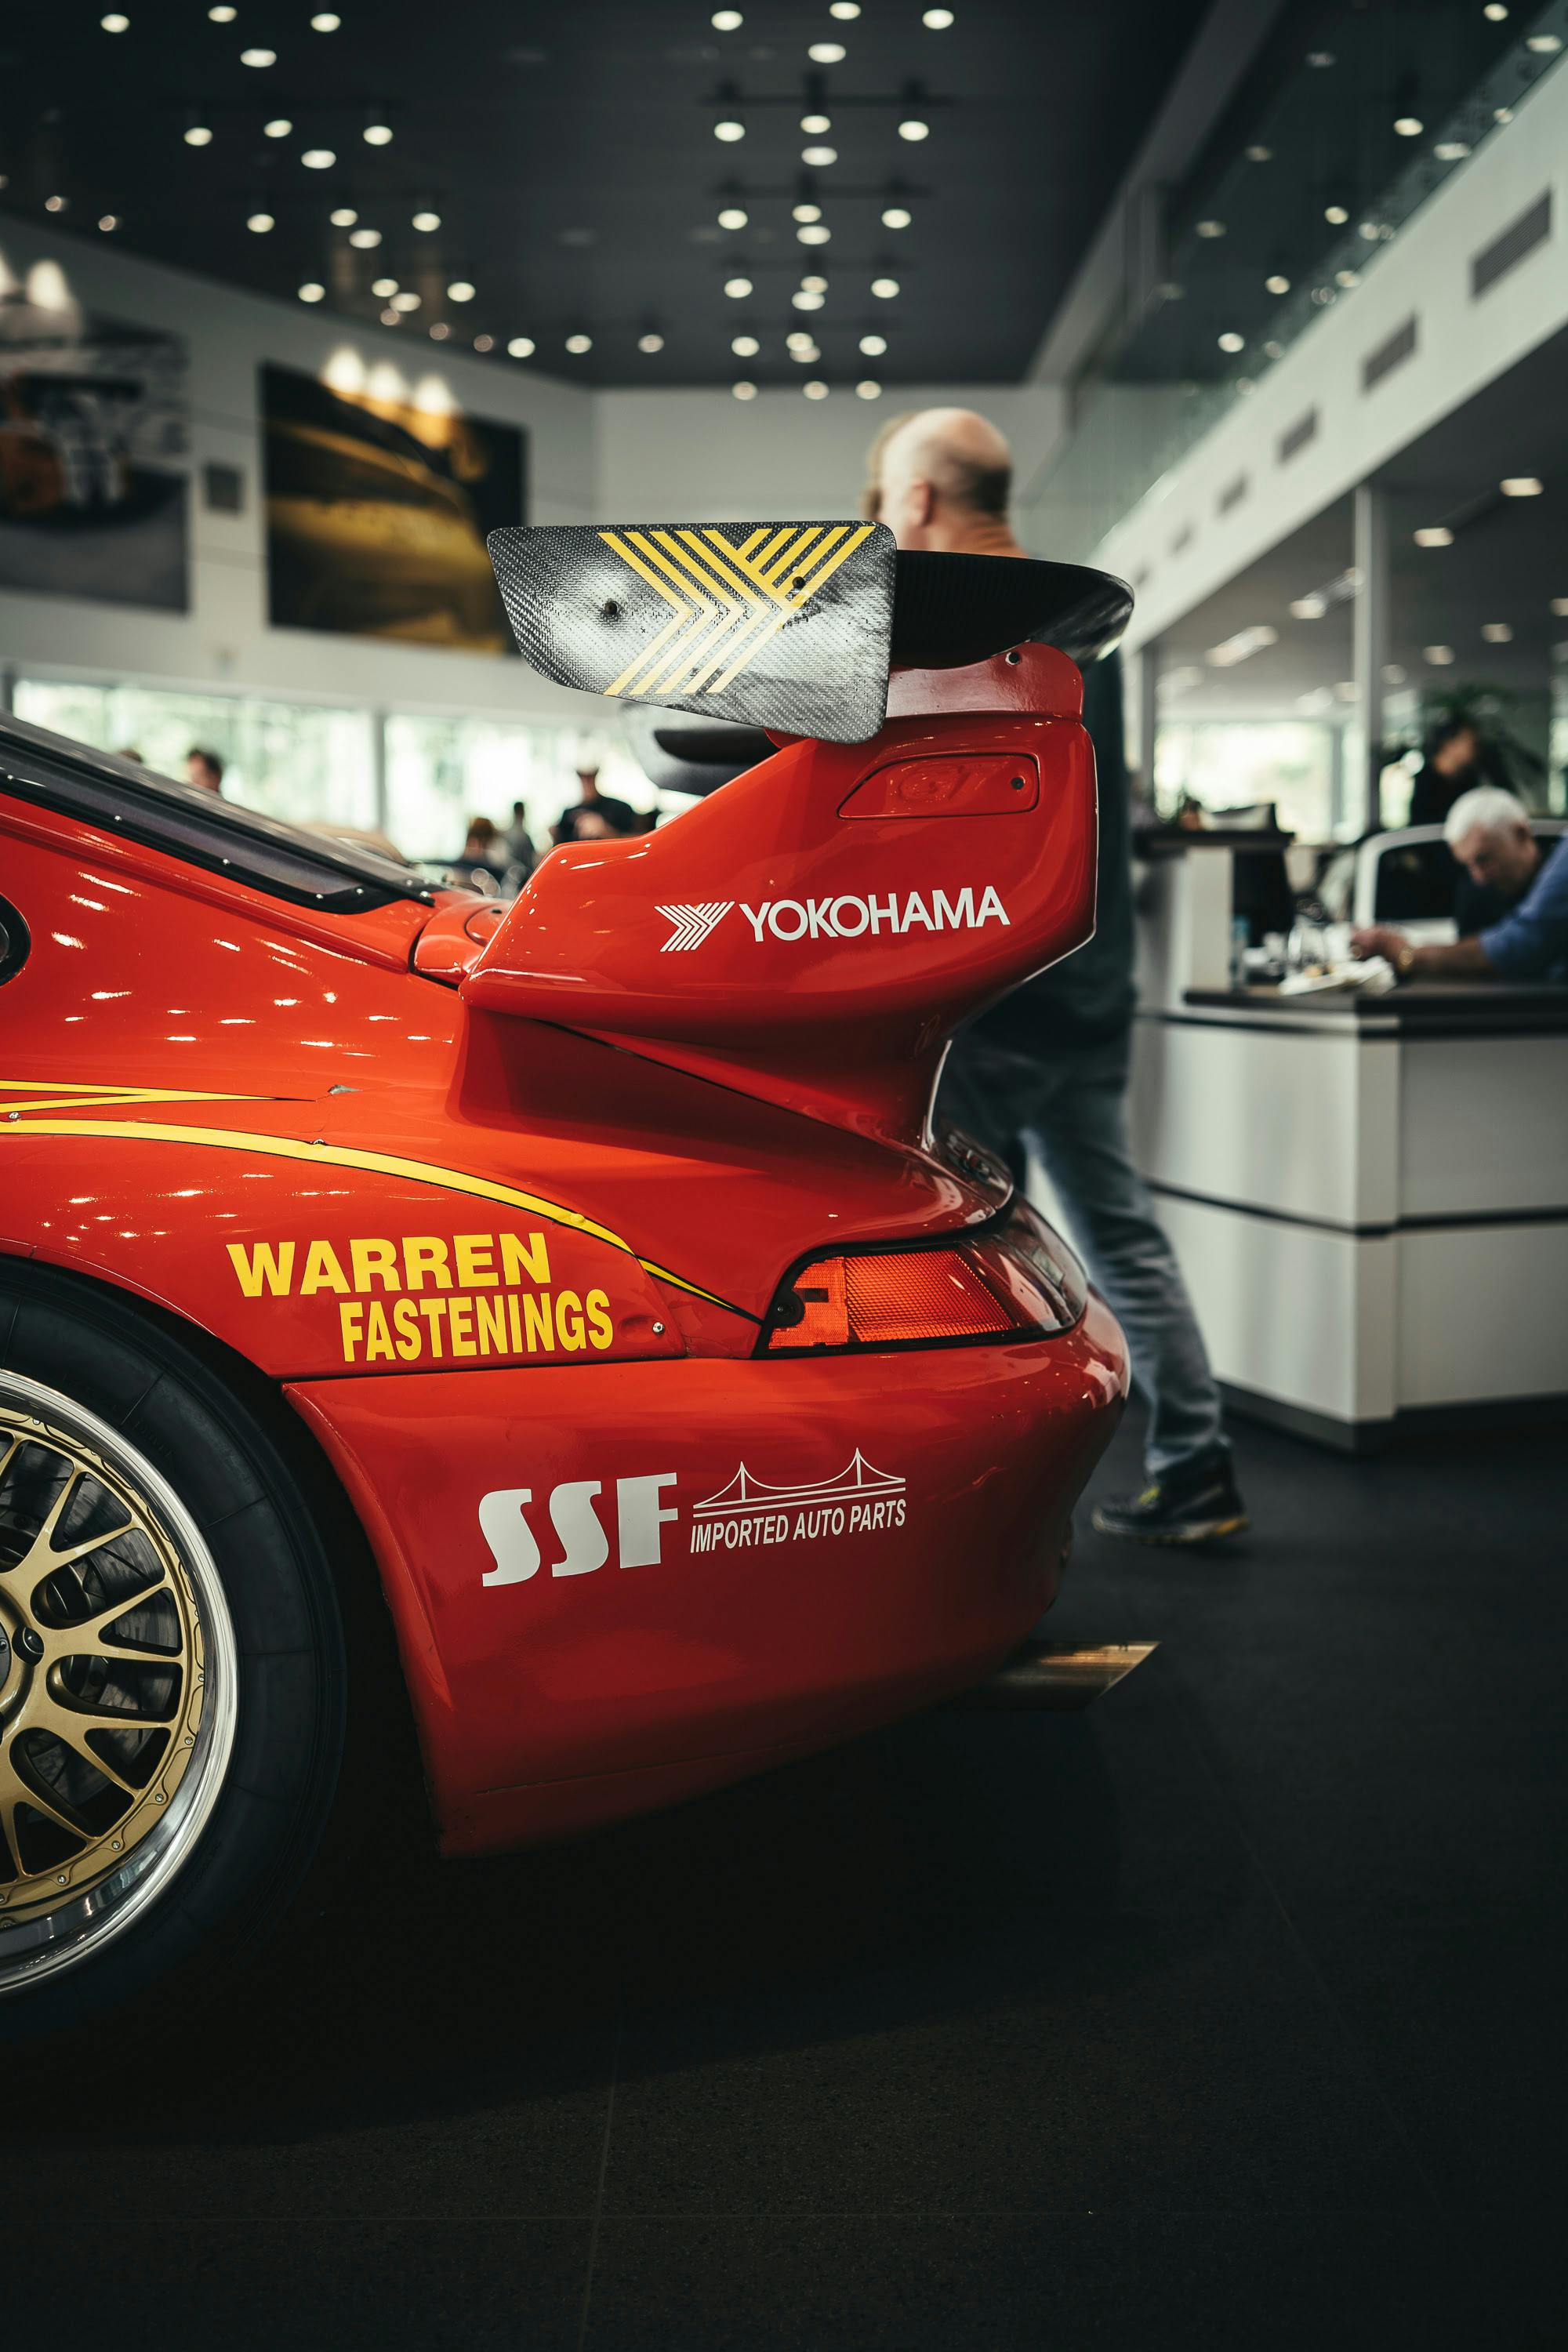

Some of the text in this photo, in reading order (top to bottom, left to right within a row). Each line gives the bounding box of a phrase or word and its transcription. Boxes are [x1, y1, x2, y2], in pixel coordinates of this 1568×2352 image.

[739, 885, 1011, 942] YOKOHAMA
[225, 1232, 551, 1298] WARREN
[339, 1288, 613, 1363] FASTENINGS
[478, 1472, 679, 1588] SSF
[690, 1498, 907, 1554] IMPORTED AUTO PARTS
